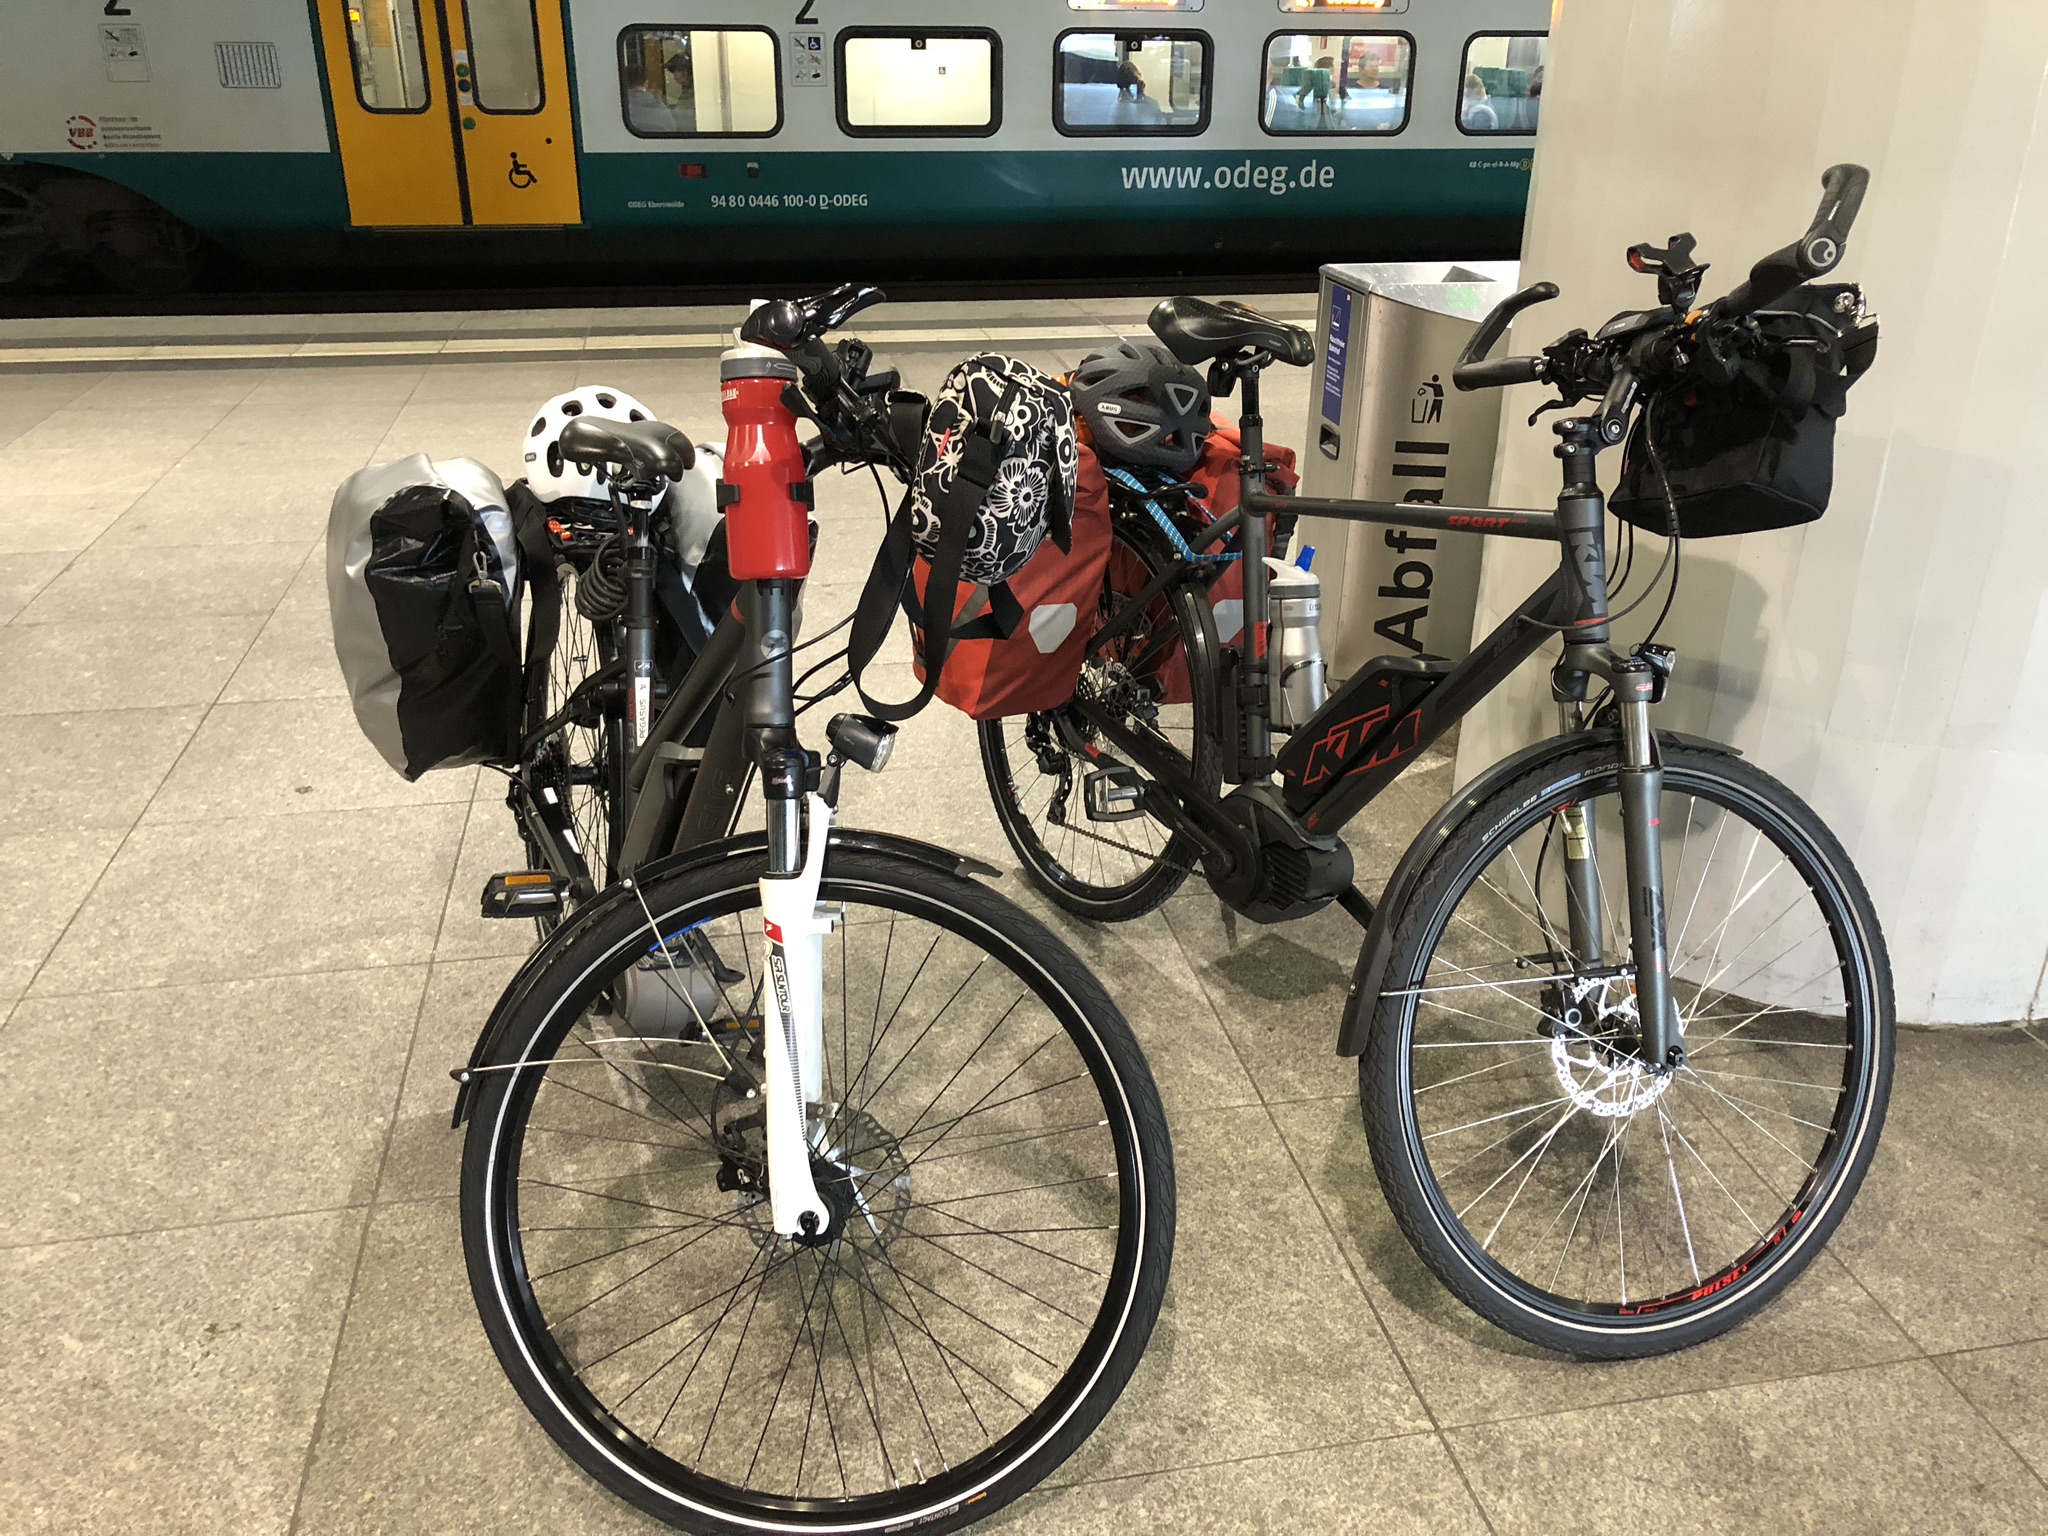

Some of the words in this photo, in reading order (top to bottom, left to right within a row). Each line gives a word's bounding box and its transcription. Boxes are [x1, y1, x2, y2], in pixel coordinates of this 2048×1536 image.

[68, 127, 94, 138] VBB
[1121, 159, 1335, 195] www.odeg.de
[749, 195, 779, 208] 0446
[783, 195, 817, 207] 100-0
[819, 194, 868, 209] D-ODEG
[1447, 515, 1510, 528] SPORT
[639, 699, 647, 739] PEGASUS
[1303, 703, 1422, 786] KTM
[1481, 794, 1538, 843] SCHWALBE
[776, 973, 791, 1013] SUNTOUR
[917, 1509, 949, 1525] CONTACT
